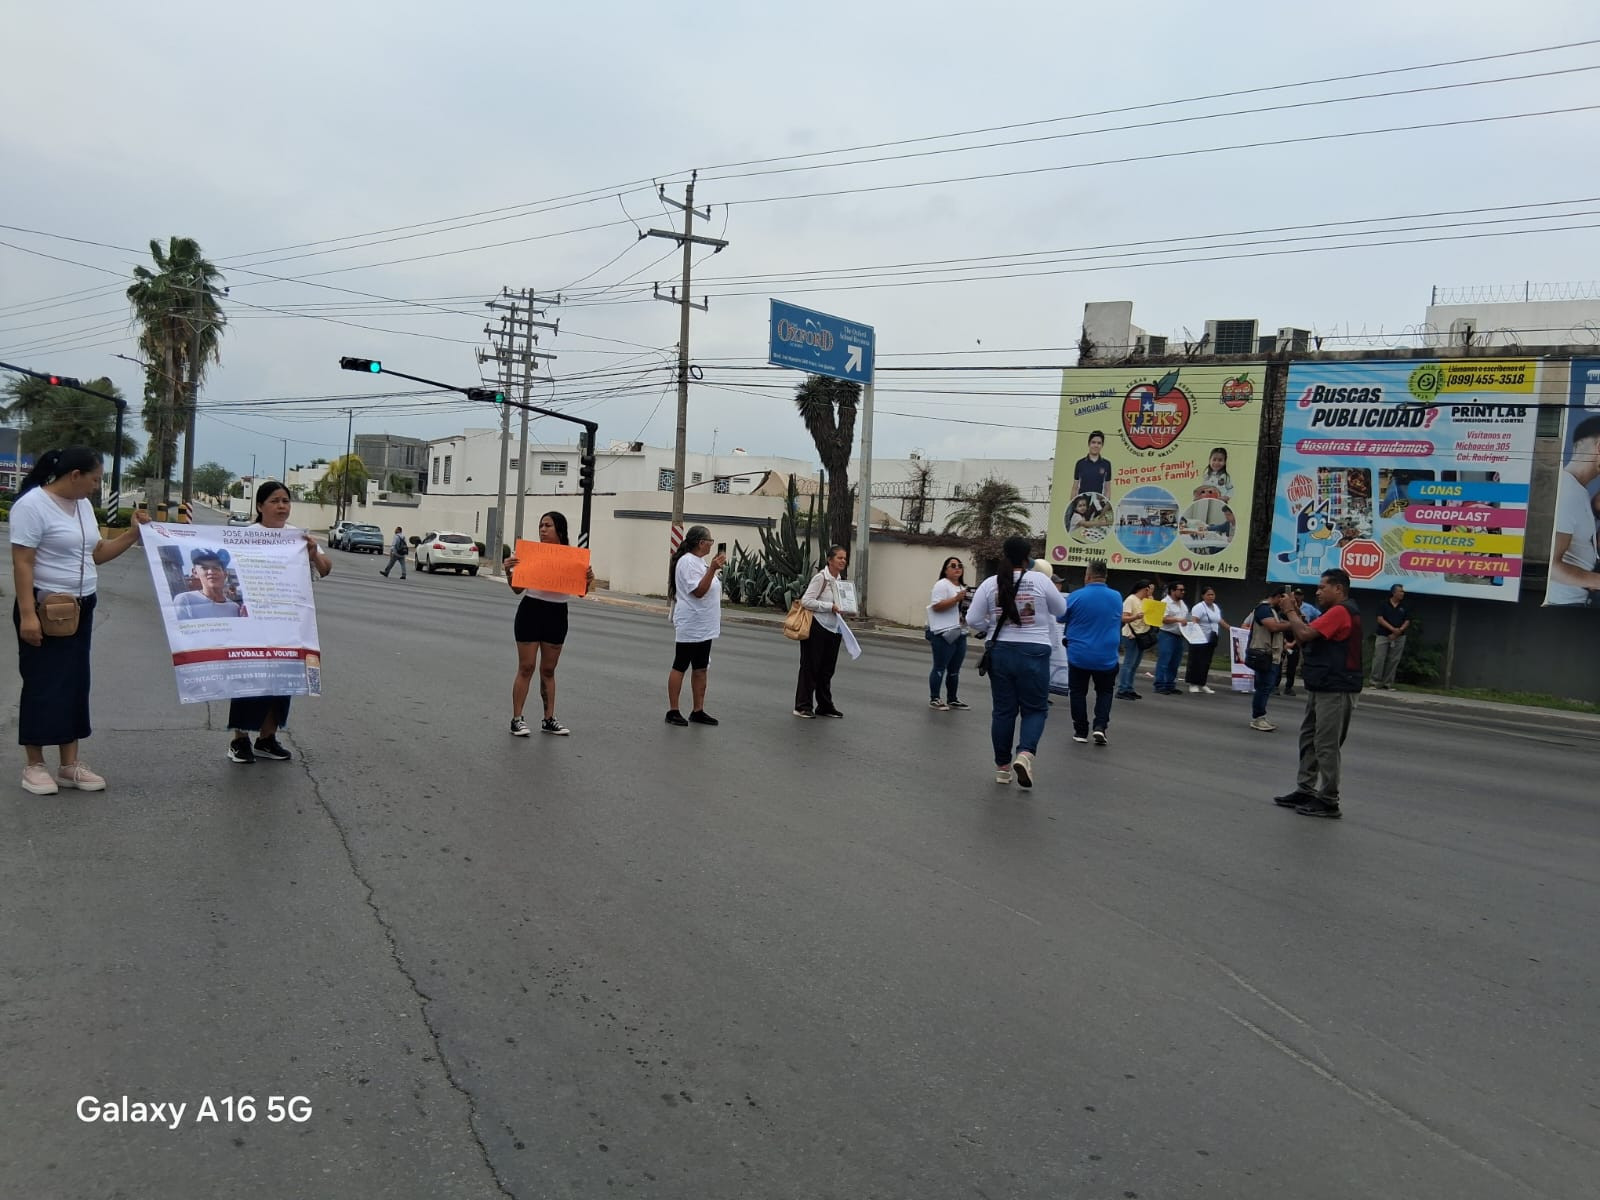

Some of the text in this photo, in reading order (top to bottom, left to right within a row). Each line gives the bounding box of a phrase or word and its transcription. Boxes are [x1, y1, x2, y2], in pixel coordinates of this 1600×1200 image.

[1126, 377, 1147, 389] TEXAS
[1446, 374, 1475, 387] (899)
[1476, 374, 1525, 385] 455-3518
[1299, 385, 1382, 408] ¿Buscas
[1074, 401, 1110, 416] LANGUAGE
[1126, 411, 1183, 427] TEKS
[1311, 406, 1439, 429] PUBLICIDAD?
[1129, 426, 1177, 435] INSTITUTE
[1302, 440, 1430, 454] Nosotros te ayudamos
[1496, 442, 1510, 450] 305
[1118, 460, 1194, 476] Join our family!
[1133, 474, 1162, 483] Texas
[1165, 469, 1199, 480] family!
[1420, 485, 1462, 496] LONAS
[1415, 509, 1491, 522] COROPLAST
[244, 530, 281, 538] ABRAHAM
[1413, 535, 1475, 547] STICKERS
[1346, 552, 1379, 567] STOP
[1410, 556, 1510, 572] DTF UV Y TEXTIL
[1193, 561, 1240, 573] Valle Alto
